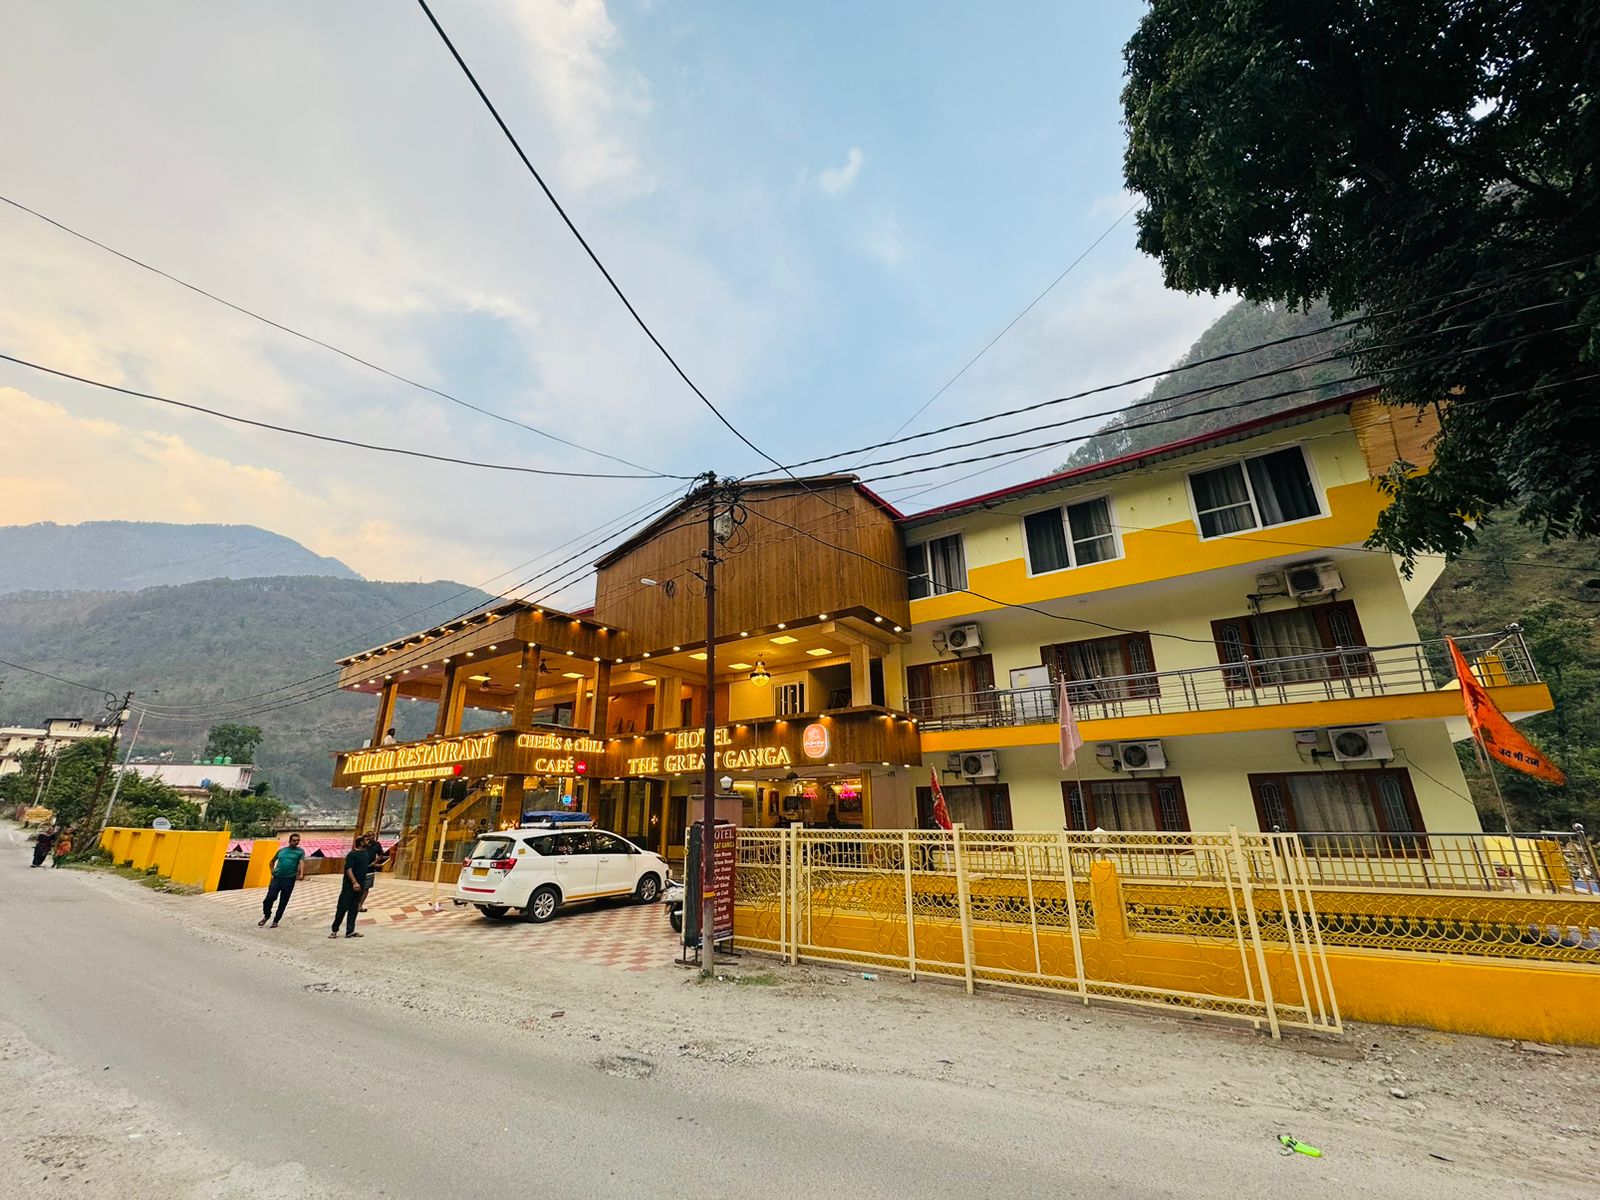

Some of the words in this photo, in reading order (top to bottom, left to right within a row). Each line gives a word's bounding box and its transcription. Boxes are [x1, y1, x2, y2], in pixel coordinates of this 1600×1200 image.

[517, 733, 563, 750] CHEERS
[564, 737, 574, 751] &
[574, 738, 605, 753] CHILL
[675, 728, 732, 749] HOTEL
[396, 735, 498, 769] RESTAURANT
[628, 757, 659, 774] THE
[664, 751, 720, 771] GREAT
[723, 746, 791, 768] GANGA
[535, 756, 575, 773] CAFÉ
[713, 829, 735, 840] OTEL
